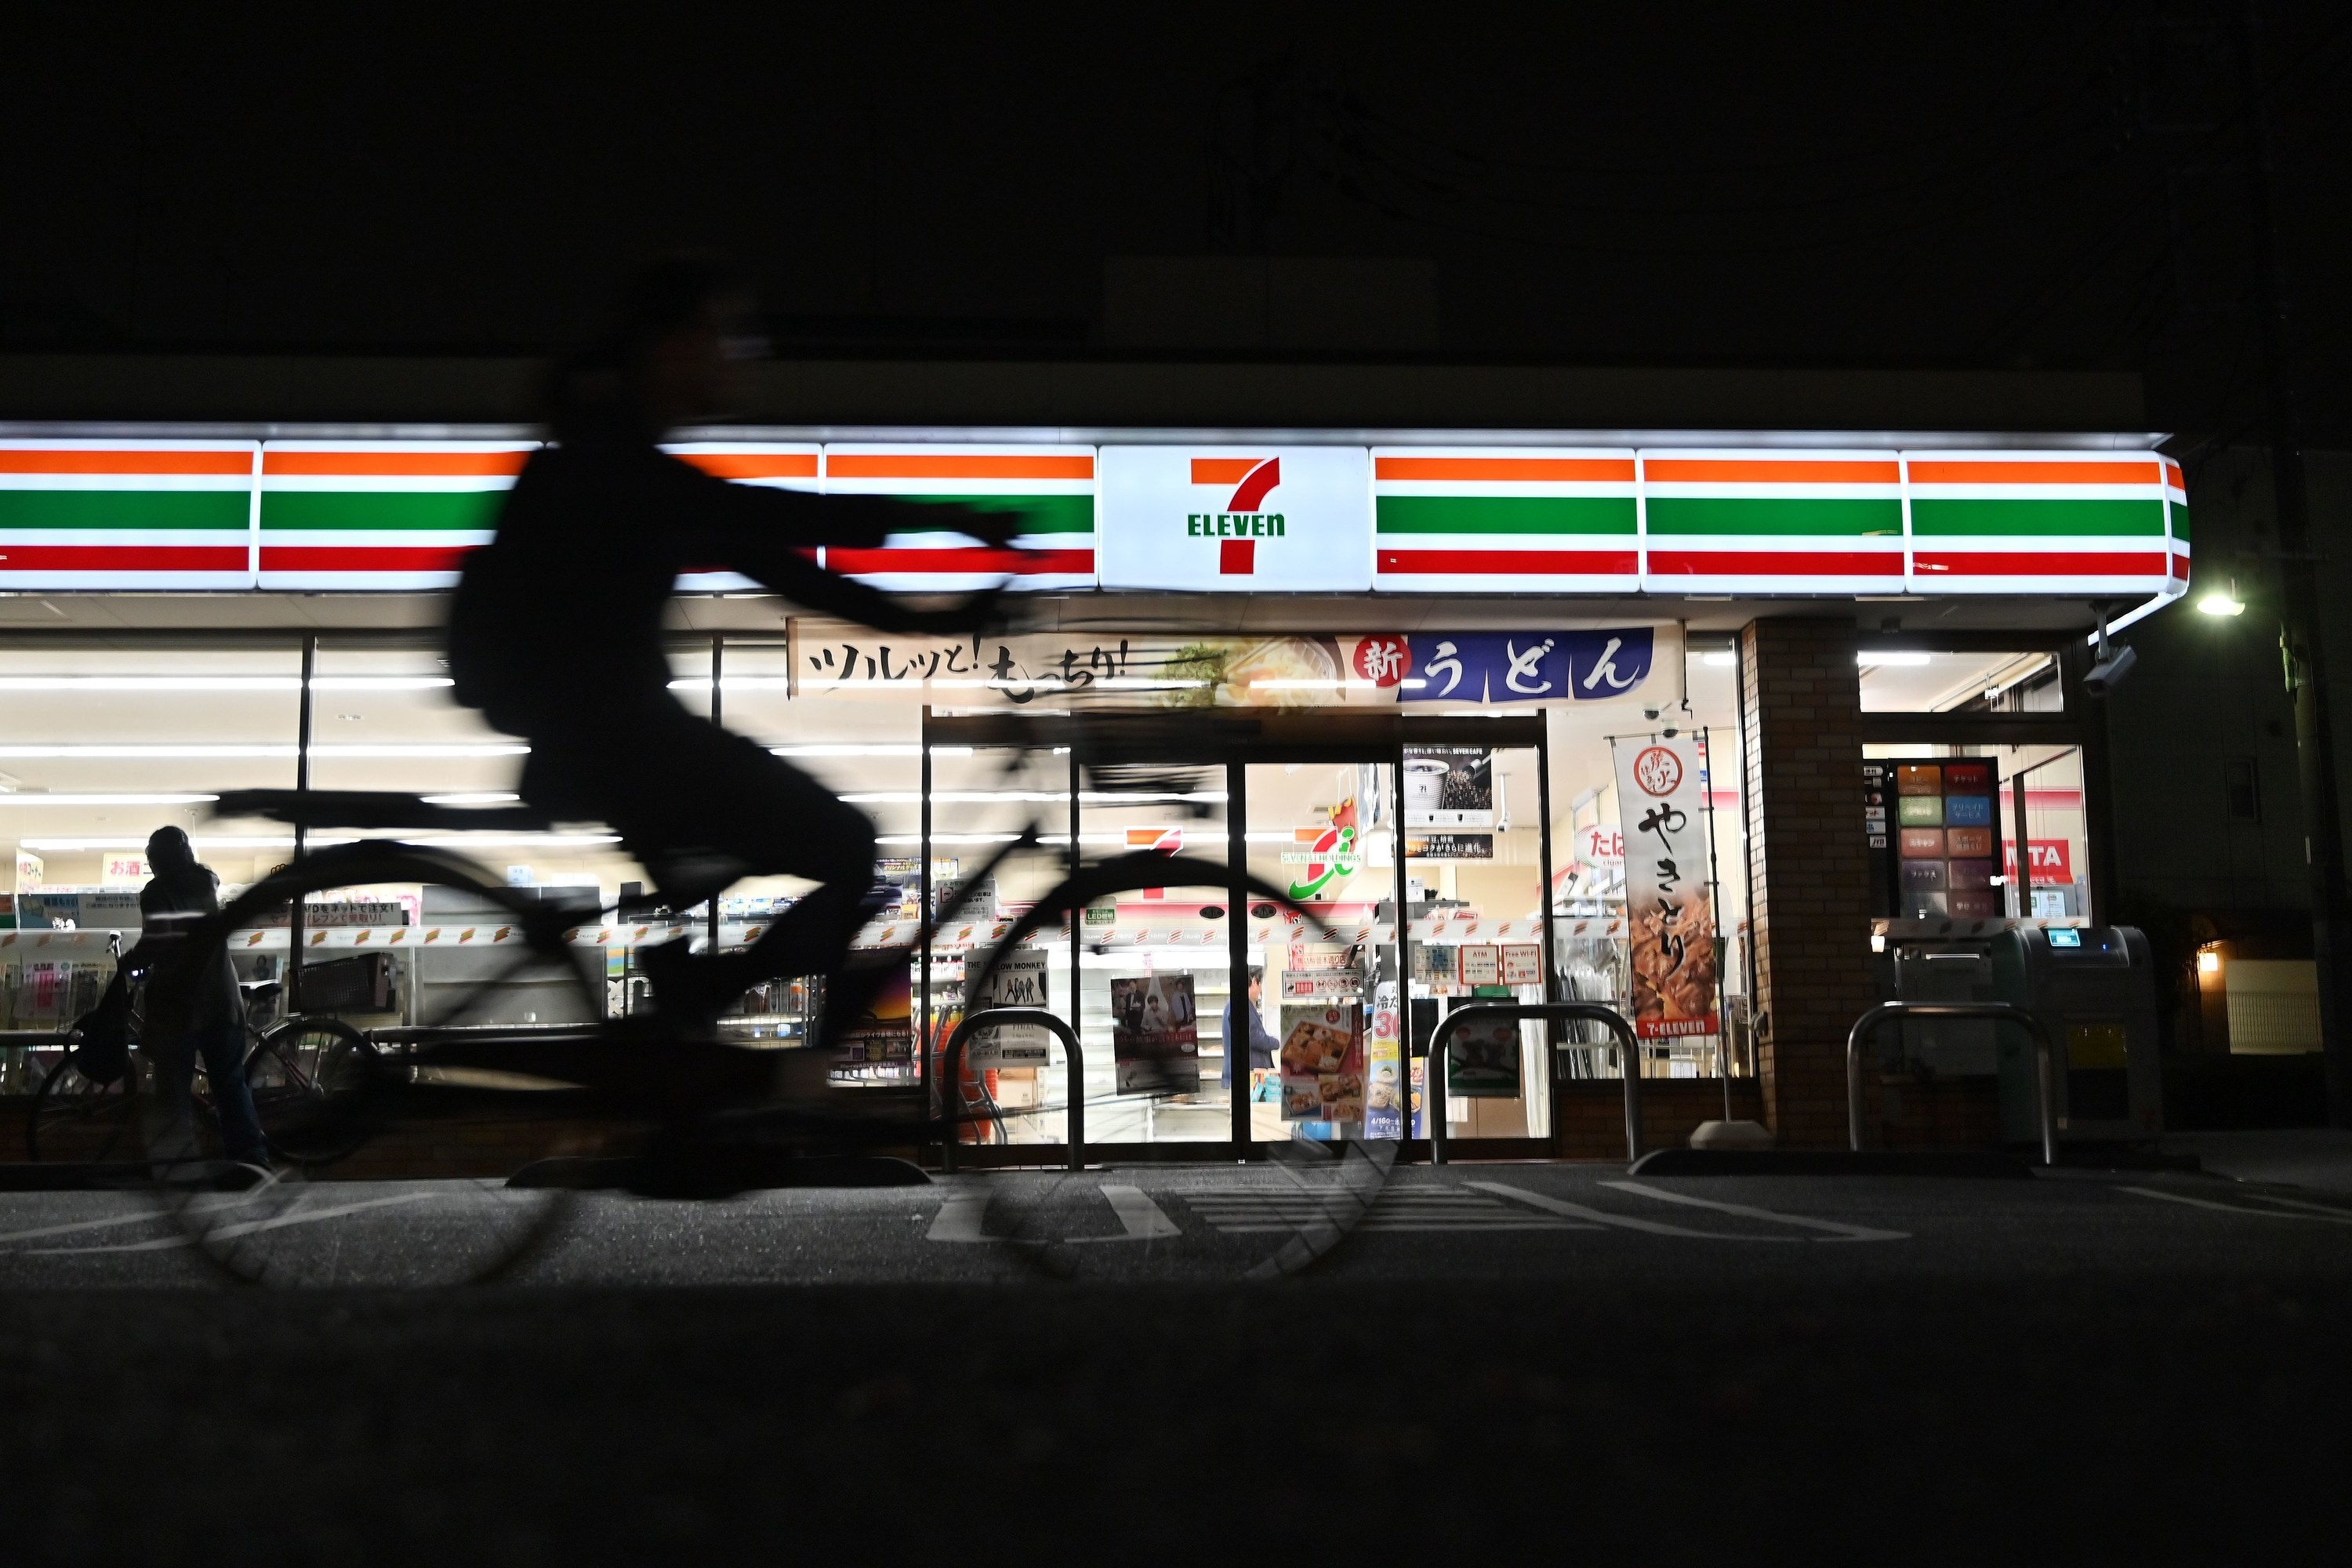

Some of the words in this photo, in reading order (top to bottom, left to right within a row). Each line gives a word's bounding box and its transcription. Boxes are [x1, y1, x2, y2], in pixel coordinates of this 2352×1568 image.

[1191, 456, 1280, 575] 7
[1363, 640, 1404, 681] 新
[1424, 636, 1640, 698] うどん
[1638, 802, 1686, 984] やきとり
[1014, 962, 1046, 971] MONKEY
